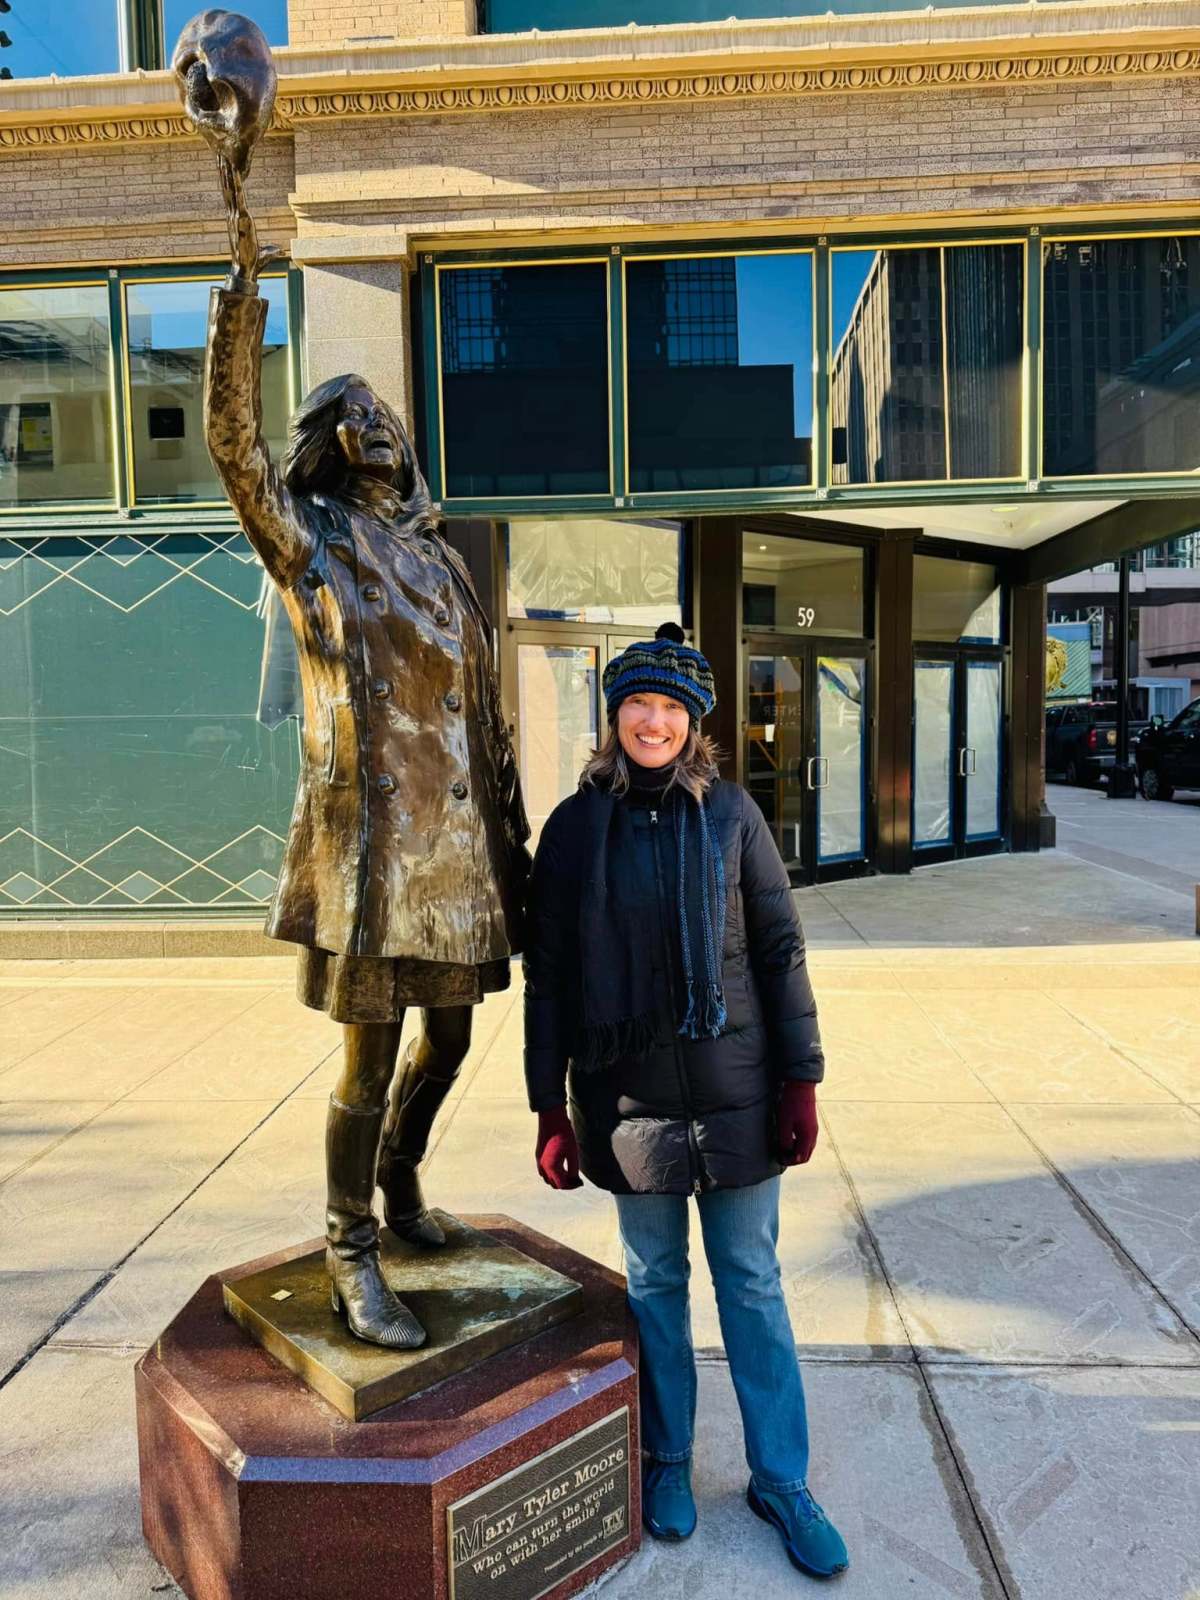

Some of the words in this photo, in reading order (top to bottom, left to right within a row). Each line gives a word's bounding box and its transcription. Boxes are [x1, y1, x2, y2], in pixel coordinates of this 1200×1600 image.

[797, 606, 815, 628] 59
[452, 1513, 517, 1564] Mary
[523, 1481, 570, 1518] Tyler
[574, 1448, 624, 1488] Moore
[472, 1551, 502, 1574] Who
[506, 1535, 528, 1555] can
[532, 1517, 559, 1539] turn
[562, 1503, 580, 1520] the
[583, 1478, 615, 1506] world
[490, 1563, 507, 1580] on
[511, 1543, 538, 1567] with
[541, 1527, 562, 1548] her
[565, 1500, 600, 1532] smile?
